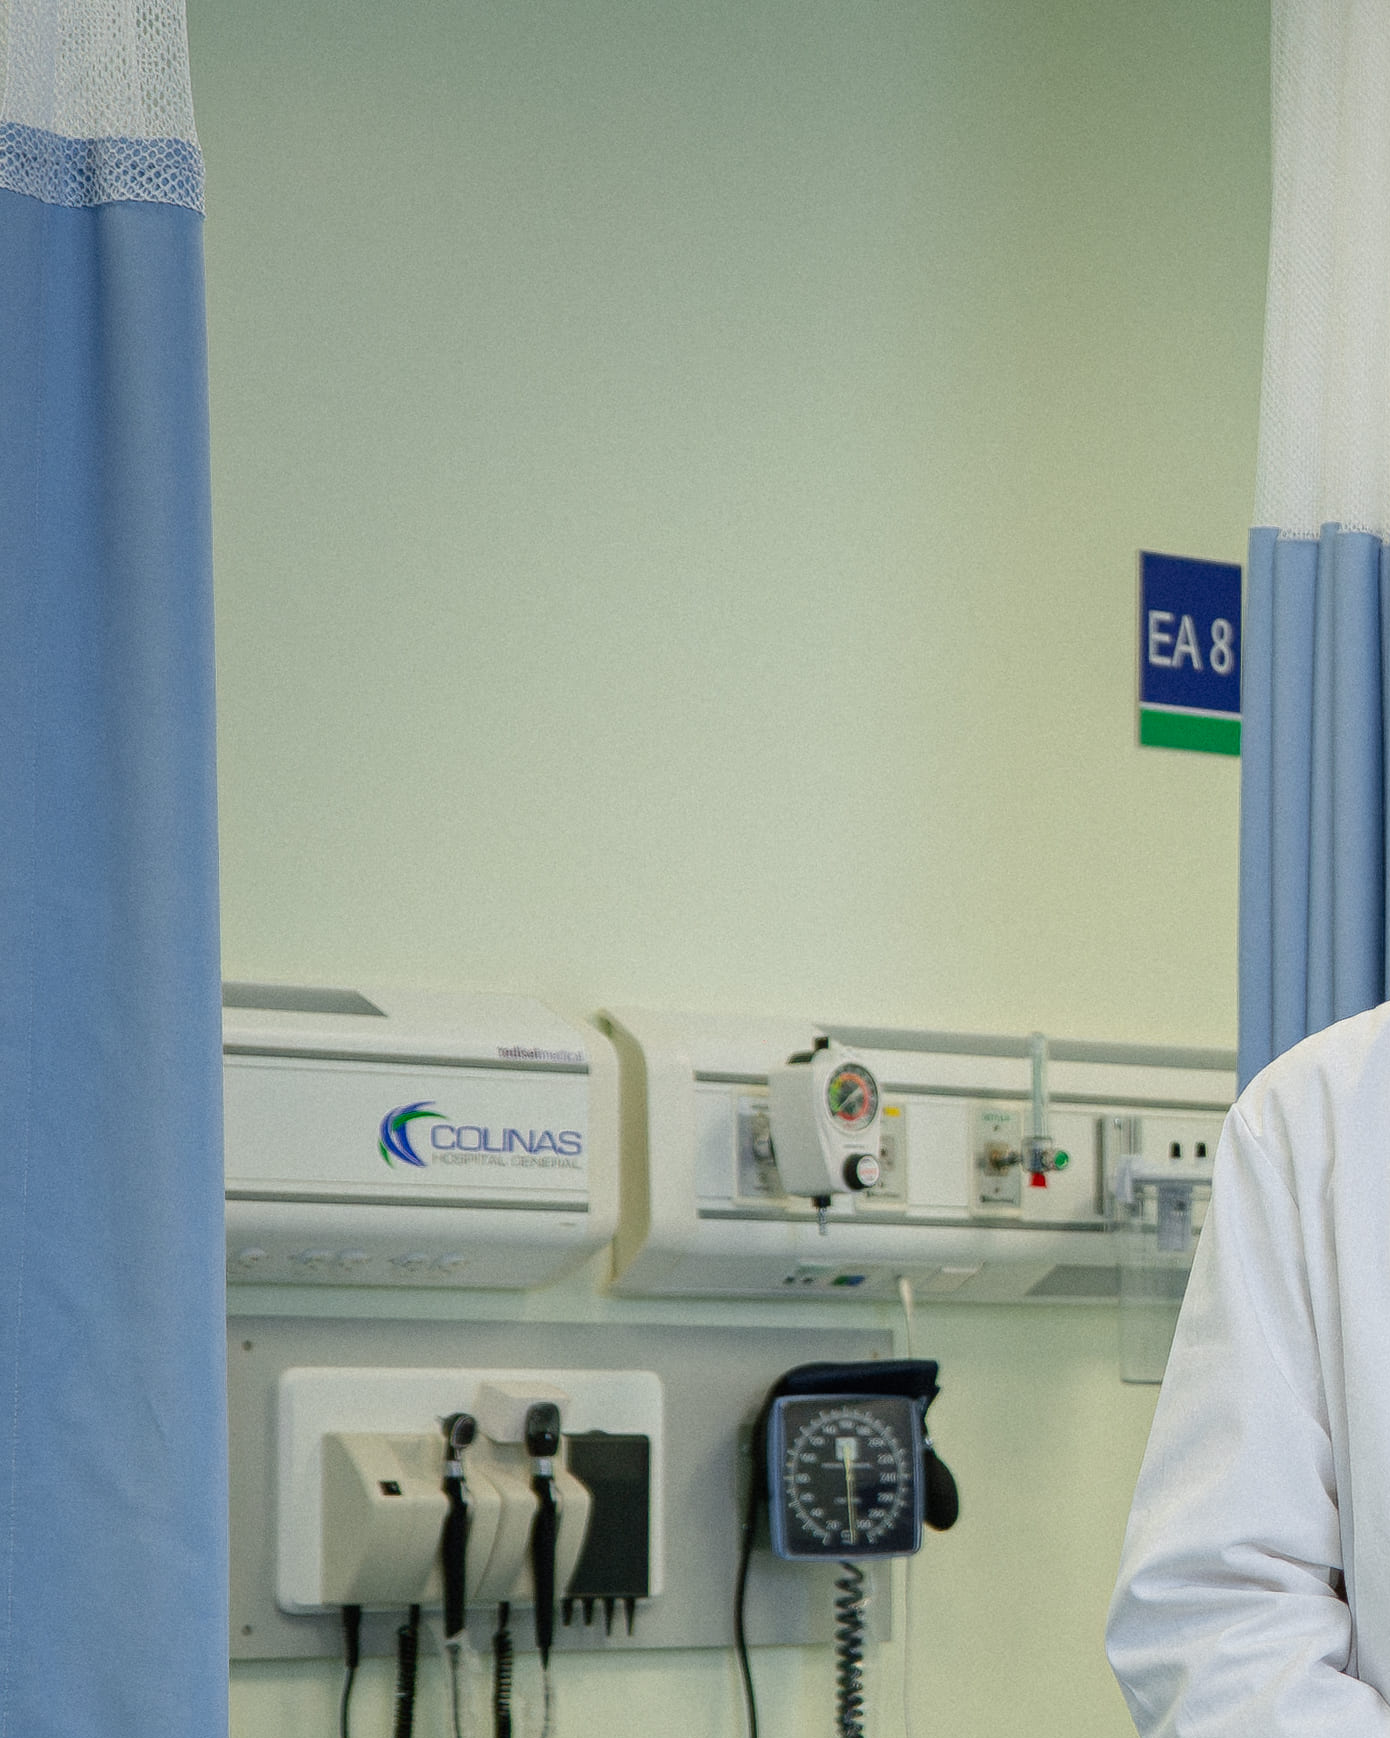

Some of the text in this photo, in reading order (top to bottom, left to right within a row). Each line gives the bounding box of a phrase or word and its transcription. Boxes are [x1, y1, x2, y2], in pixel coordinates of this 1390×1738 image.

[1148, 609, 1235, 675] EA 8
[430, 1124, 583, 1157] COLINAS
